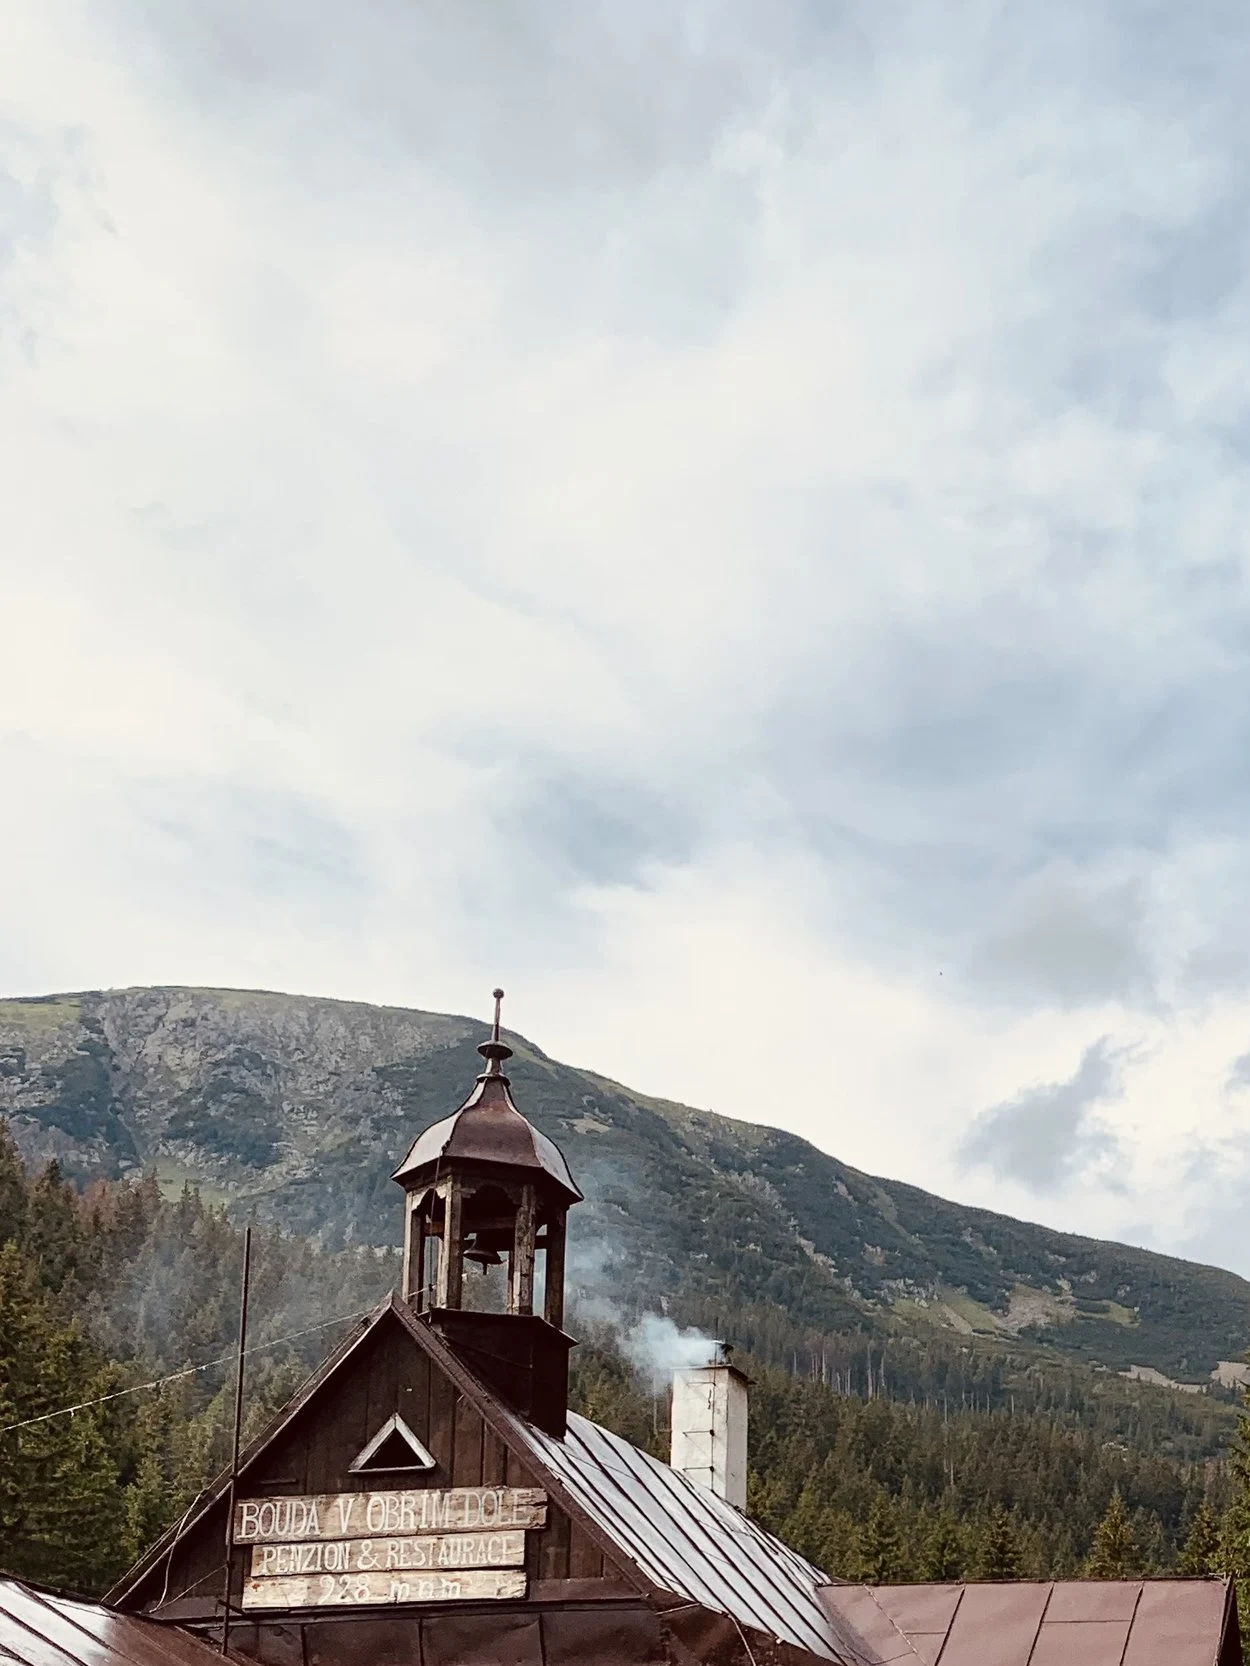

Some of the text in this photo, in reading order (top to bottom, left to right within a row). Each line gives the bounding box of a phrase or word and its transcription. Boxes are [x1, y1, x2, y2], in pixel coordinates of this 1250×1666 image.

[237, 1501, 320, 1538] BOUDA
[339, 1498, 354, 1533] V
[462, 1490, 531, 1526] DOLE
[261, 1536, 516, 1575] PENZION & RESTAURACE
[318, 1574, 370, 1605] 928
